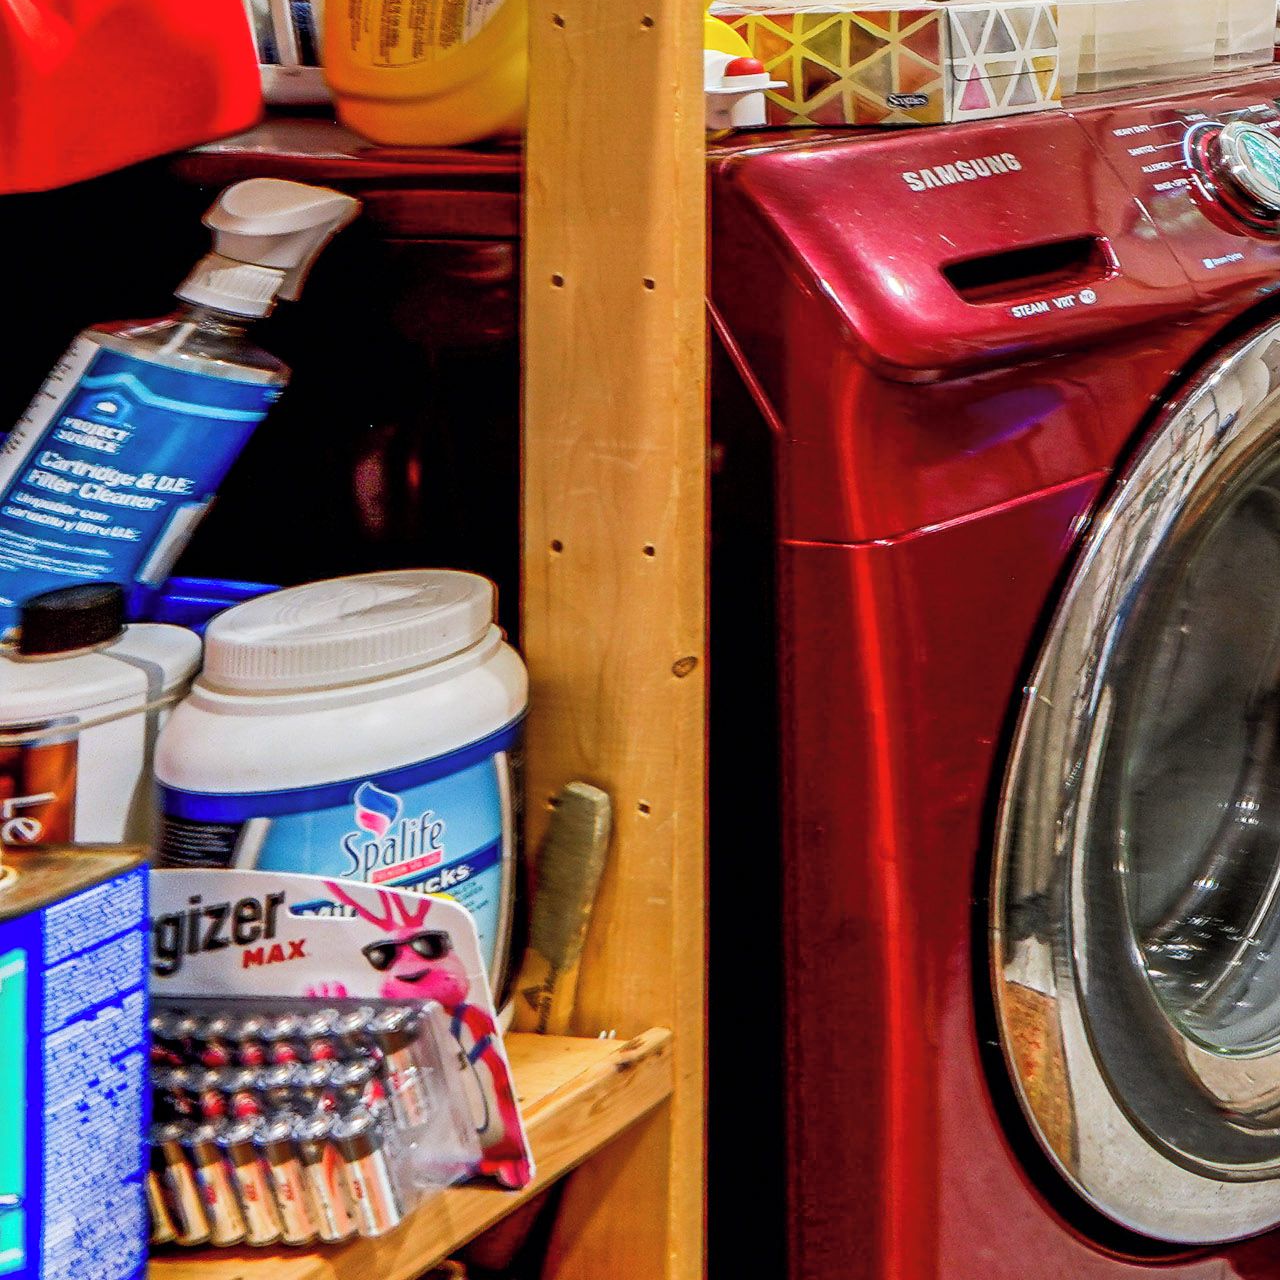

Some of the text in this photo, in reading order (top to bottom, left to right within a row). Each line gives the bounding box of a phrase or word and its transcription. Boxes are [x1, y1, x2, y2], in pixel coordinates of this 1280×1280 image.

[902, 152, 1023, 193] SAMSUNG
[1010, 300, 1050, 319] STEAM
[62, 416, 132, 442] PROJECT
[26, 469, 167, 511] Filter Cleaner
[39, 450, 137, 487] Cartridge
[135, 473, 156, 492] &
[340, 810, 443, 882] Spalife
[242, 937, 307, 970] MAX
